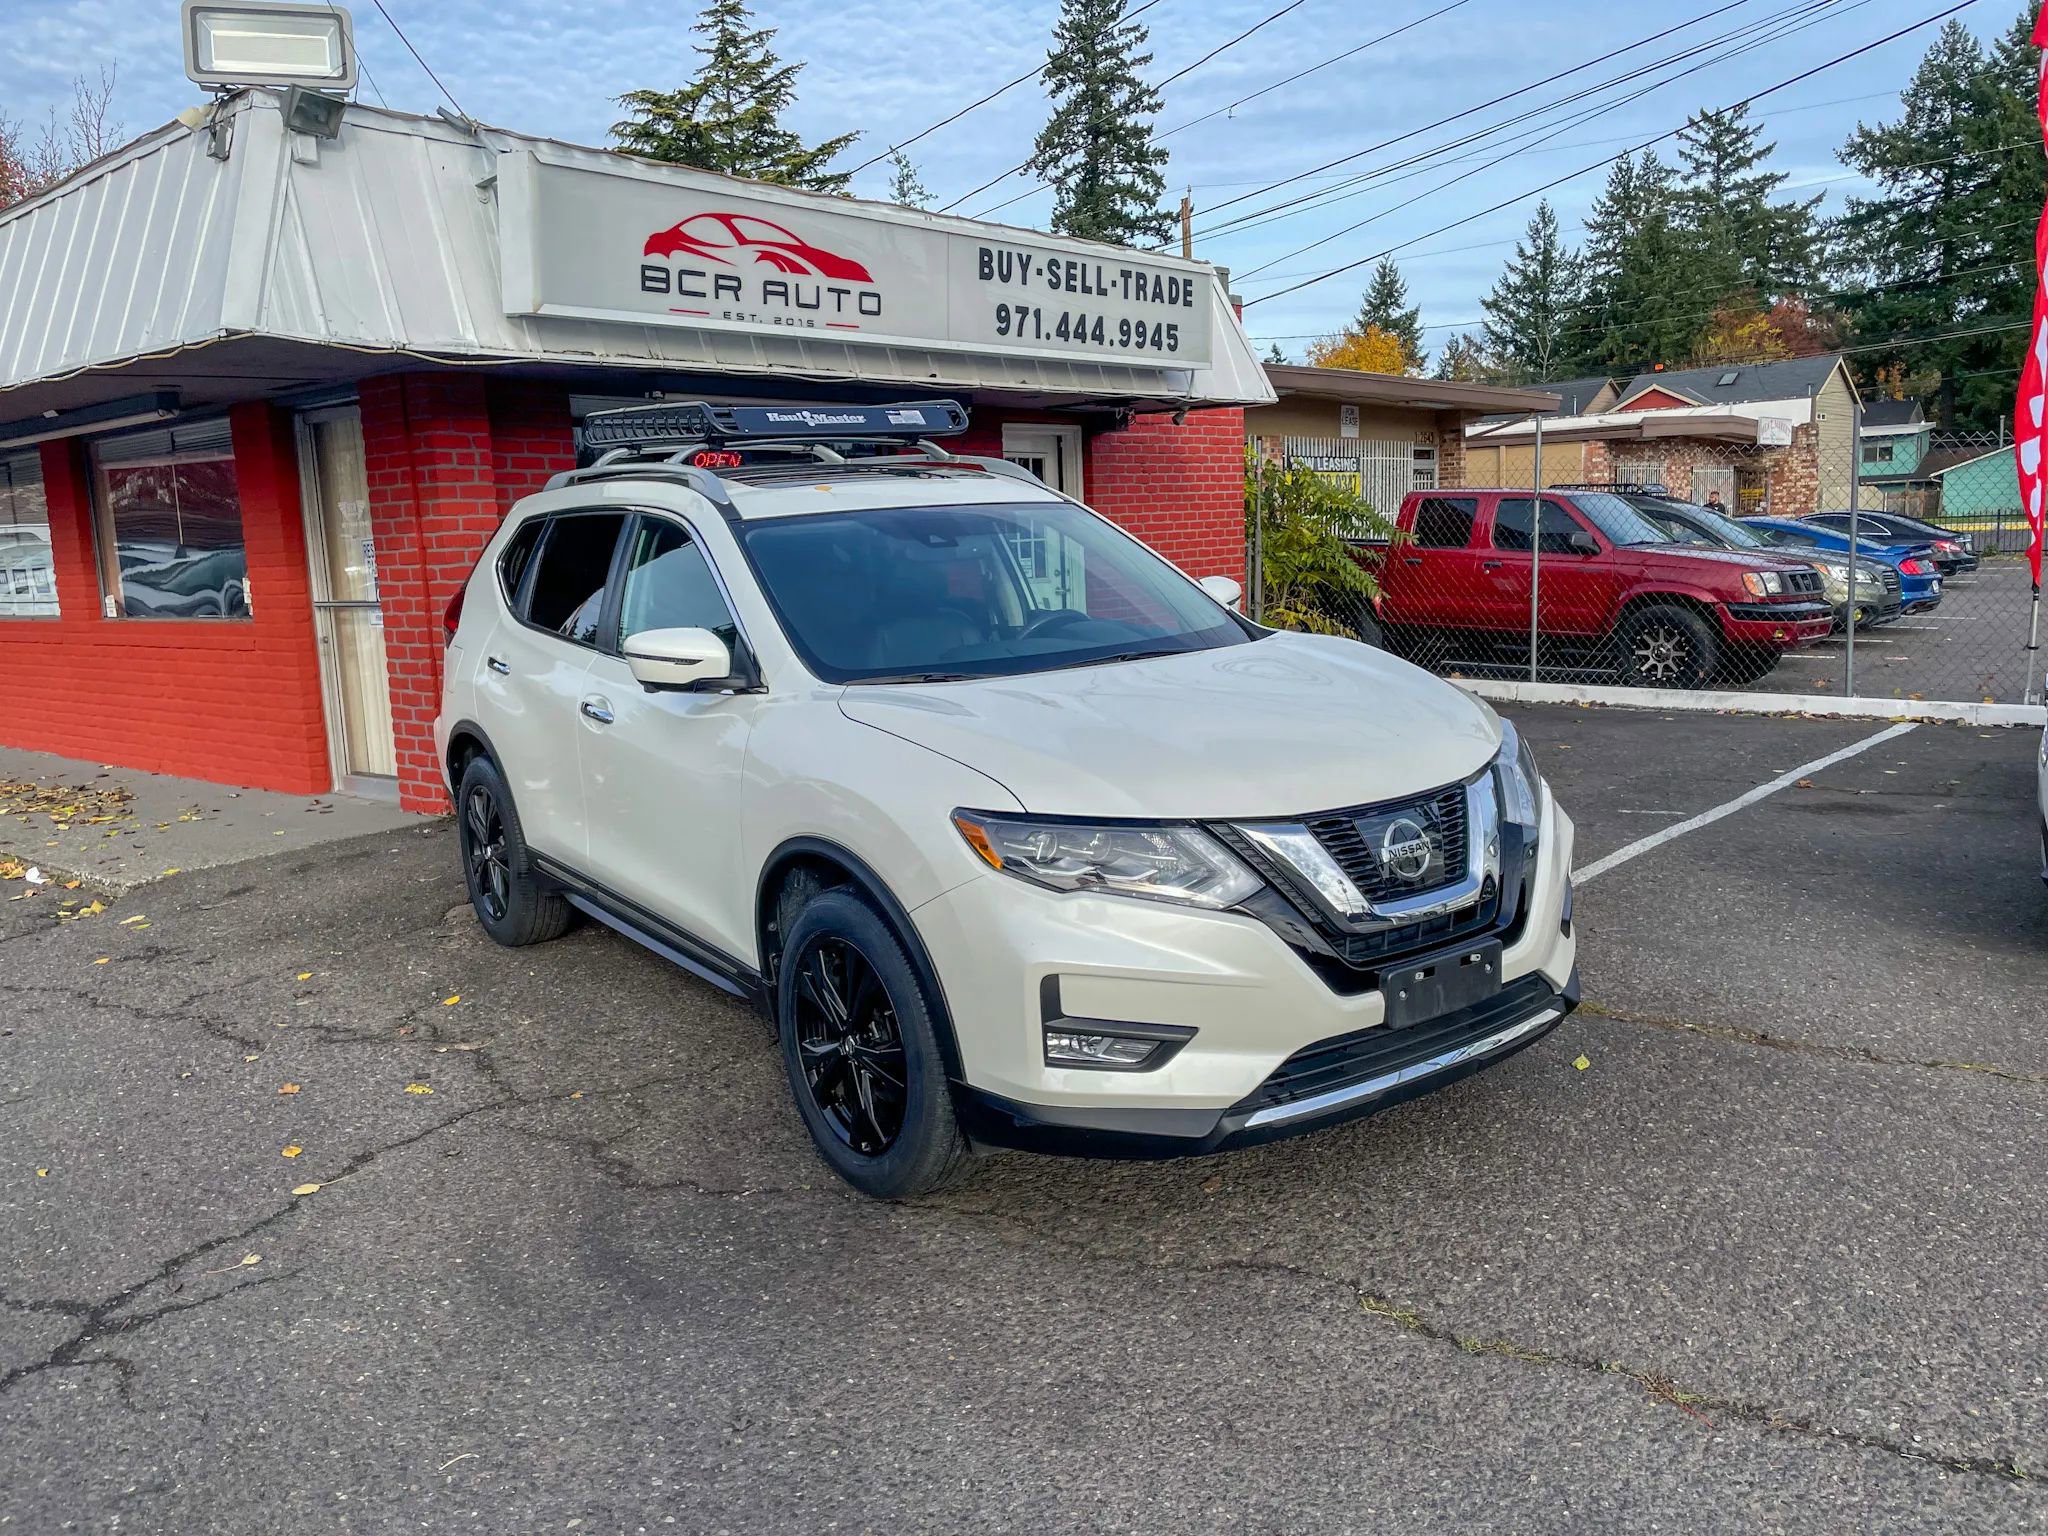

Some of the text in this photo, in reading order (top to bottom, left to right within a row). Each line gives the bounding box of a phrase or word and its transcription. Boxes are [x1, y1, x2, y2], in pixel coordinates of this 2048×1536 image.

[641, 264, 881, 316] BCR AUTO
[723, 311, 815, 328] EST. 2015
[996, 303, 1179, 352] 971.444.9945
[766, 412, 866, 424] Haul Master
[1341, 416, 1358, 426] LEASE
[694, 452, 742, 468] OPEN
[1318, 457, 1357, 471] LEASING
[1389, 840, 1430, 858] NISSAN
